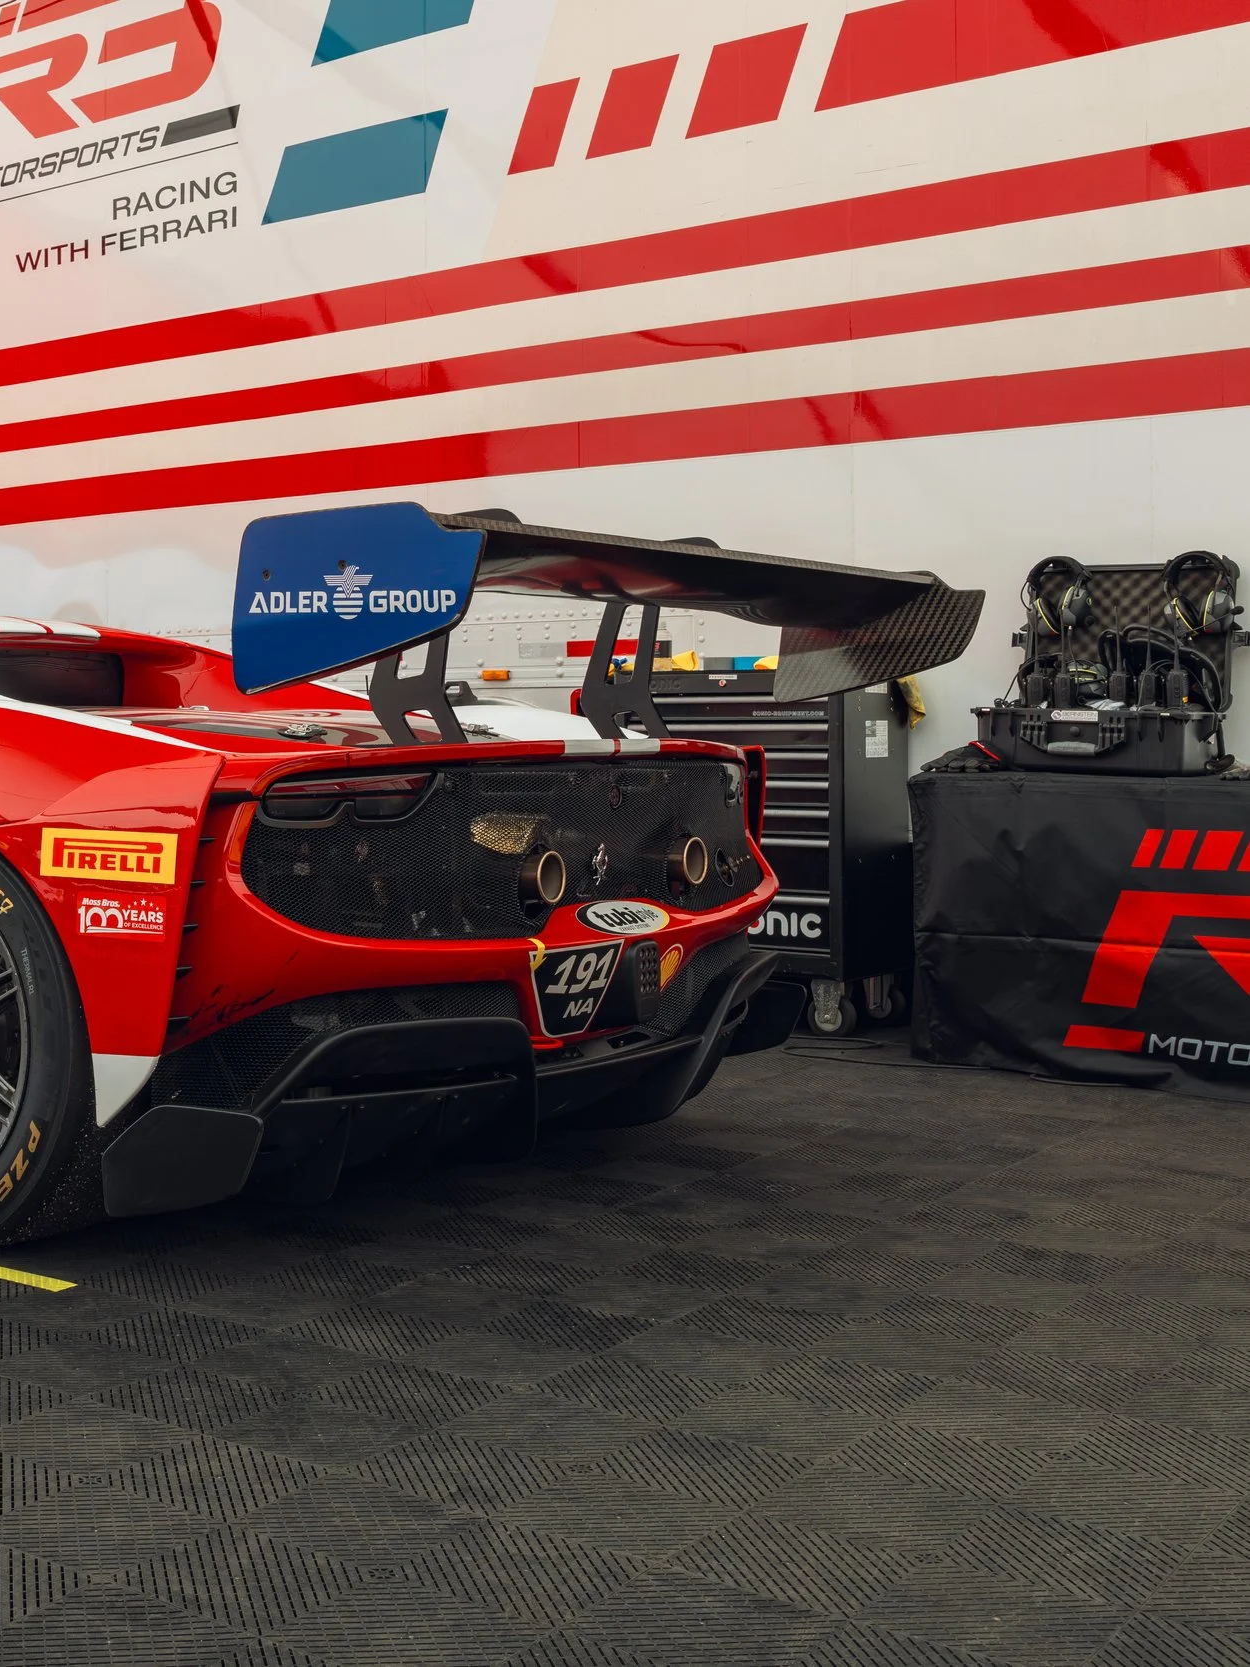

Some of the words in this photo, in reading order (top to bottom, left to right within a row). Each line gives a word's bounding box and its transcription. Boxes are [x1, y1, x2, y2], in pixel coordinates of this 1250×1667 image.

[112, 171, 238, 221] RACING
[15, 239, 89, 273] WITH
[101, 206, 238, 256] FERRARI
[249, 591, 328, 613] ADLER
[368, 590, 457, 613] GROUP
[52, 837, 164, 874] PIRELLI
[82, 897, 101, 906] Moss
[101, 898, 120, 908] Bros.
[78, 905, 123, 933] 100
[122, 909, 164, 923] YEARS
[132, 922, 164, 931] EXCELLENCE
[545, 948, 615, 994] 191
[562, 997, 594, 1019] NA
